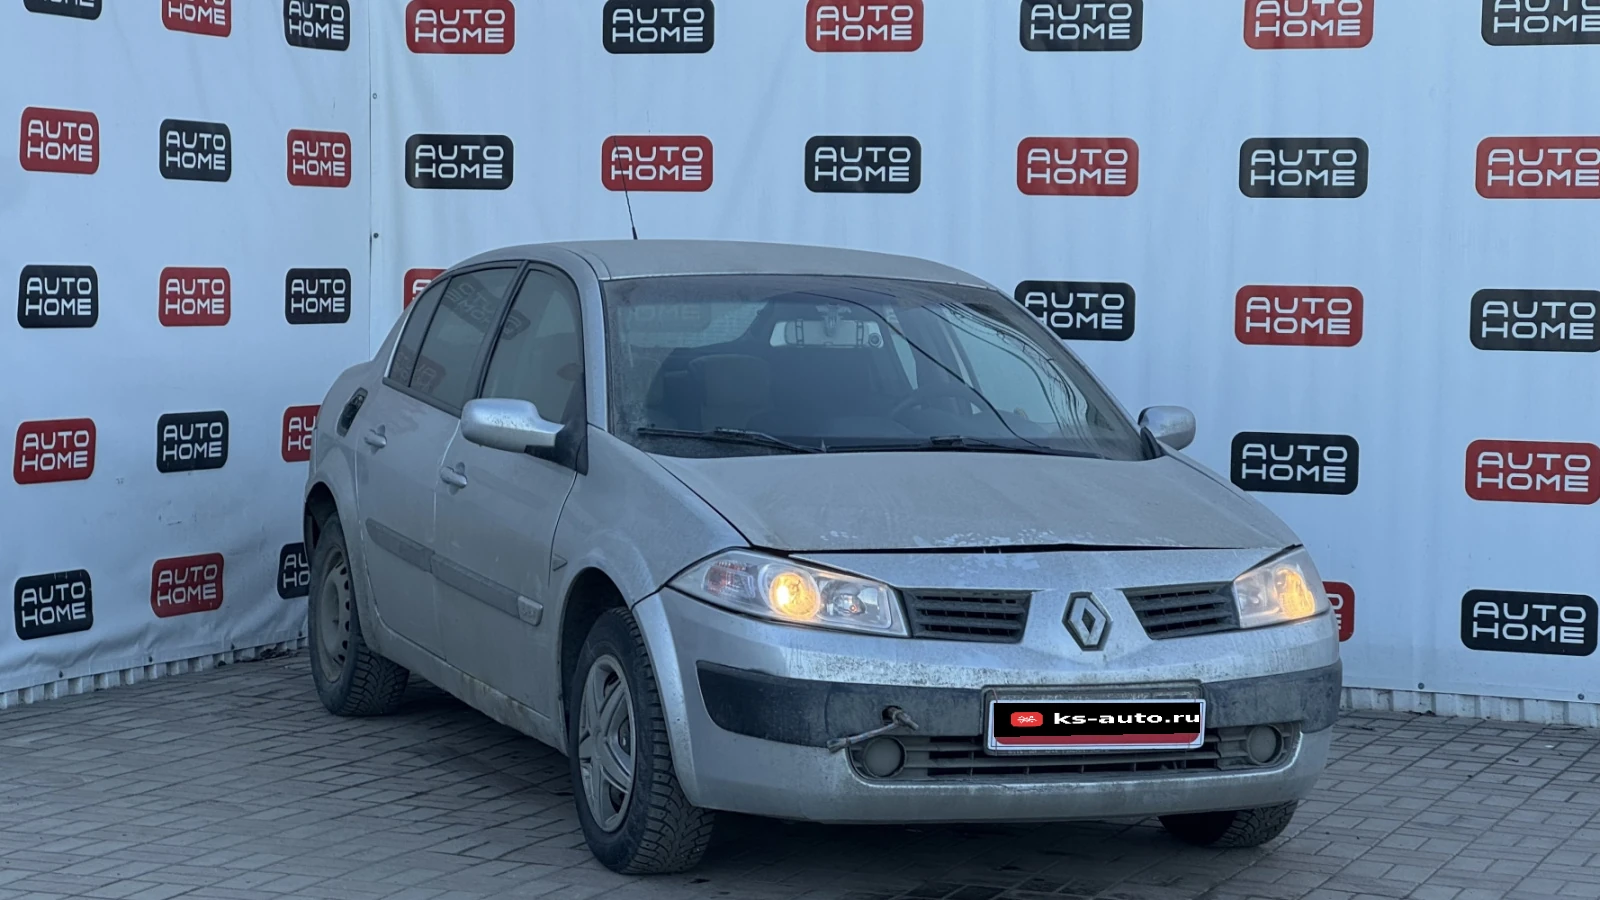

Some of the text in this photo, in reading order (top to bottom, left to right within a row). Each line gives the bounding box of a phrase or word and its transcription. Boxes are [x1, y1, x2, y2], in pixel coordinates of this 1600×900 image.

[168, 1, 226, 26] HOME
[289, 0, 344, 22] AUTO
[415, 9, 505, 25] AUTO
[612, 8, 705, 24] AUTO
[816, 5, 913, 22] AUTO
[1031, 3, 1132, 20] AUTO
[1256, 0, 1363, 17] AUTO
[289, 19, 344, 40] HOME
[816, 24, 912, 41] HOME
[1030, 23, 1130, 40] HOME
[1255, 19, 1361, 37] HOME
[1493, 14, 1600, 33] HOME
[415, 27, 504, 43] HOME
[612, 26, 703, 43] HOME
[28, 119, 93, 141] AUTO
[166, 131, 226, 151] AUTO
[292, 140, 346, 158] AUTO
[27, 140, 92, 162] HOME
[166, 150, 225, 170] HOME
[415, 145, 504, 161] AUTO
[611, 146, 703, 162] AUTO
[815, 147, 911, 163] AUTO
[1027, 148, 1128, 165] AUTO
[1251, 149, 1357, 166] AUTO
[1488, 148, 1600, 166] AUTO
[293, 159, 345, 177] HOME
[415, 162, 503, 179] HOME
[611, 165, 702, 181] HOME
[815, 166, 909, 182] HOME
[1027, 168, 1126, 185] HOME
[1250, 169, 1355, 186] HOME
[1487, 169, 1599, 186] HOME
[27, 277, 92, 295] AUTO
[166, 279, 225, 295] AUTO
[291, 279, 346, 294] AUTO
[25, 298, 91, 316] HOME
[165, 298, 224, 315] HOME
[291, 297, 345, 313] HOME
[1024, 292, 1124, 310] AUTO
[1246, 297, 1352, 315] AUTO
[1482, 301, 1596, 319] AUTO
[1246, 316, 1350, 335] HOME
[1482, 321, 1594, 340] HOME
[163, 422, 223, 441] AUTO
[289, 416, 316, 433] AU
[23, 430, 89, 451] AUTO
[288, 435, 312, 451] HO
[163, 441, 222, 461] HOME
[1242, 443, 1348, 463] AUTO
[21, 450, 88, 472] HOME
[1477, 452, 1591, 472] AUTO
[1242, 463, 1346, 483] HOME
[1477, 472, 1589, 492] HOME
[284, 553, 309, 570] AU
[158, 564, 217, 587] AUTO
[283, 570, 310, 589] HO
[21, 581, 85, 607] AUTO
[157, 583, 216, 607] HOME
[21, 602, 86, 628] HOME
[1473, 601, 1586, 623] AUTO
[1473, 621, 1584, 644] HOME
